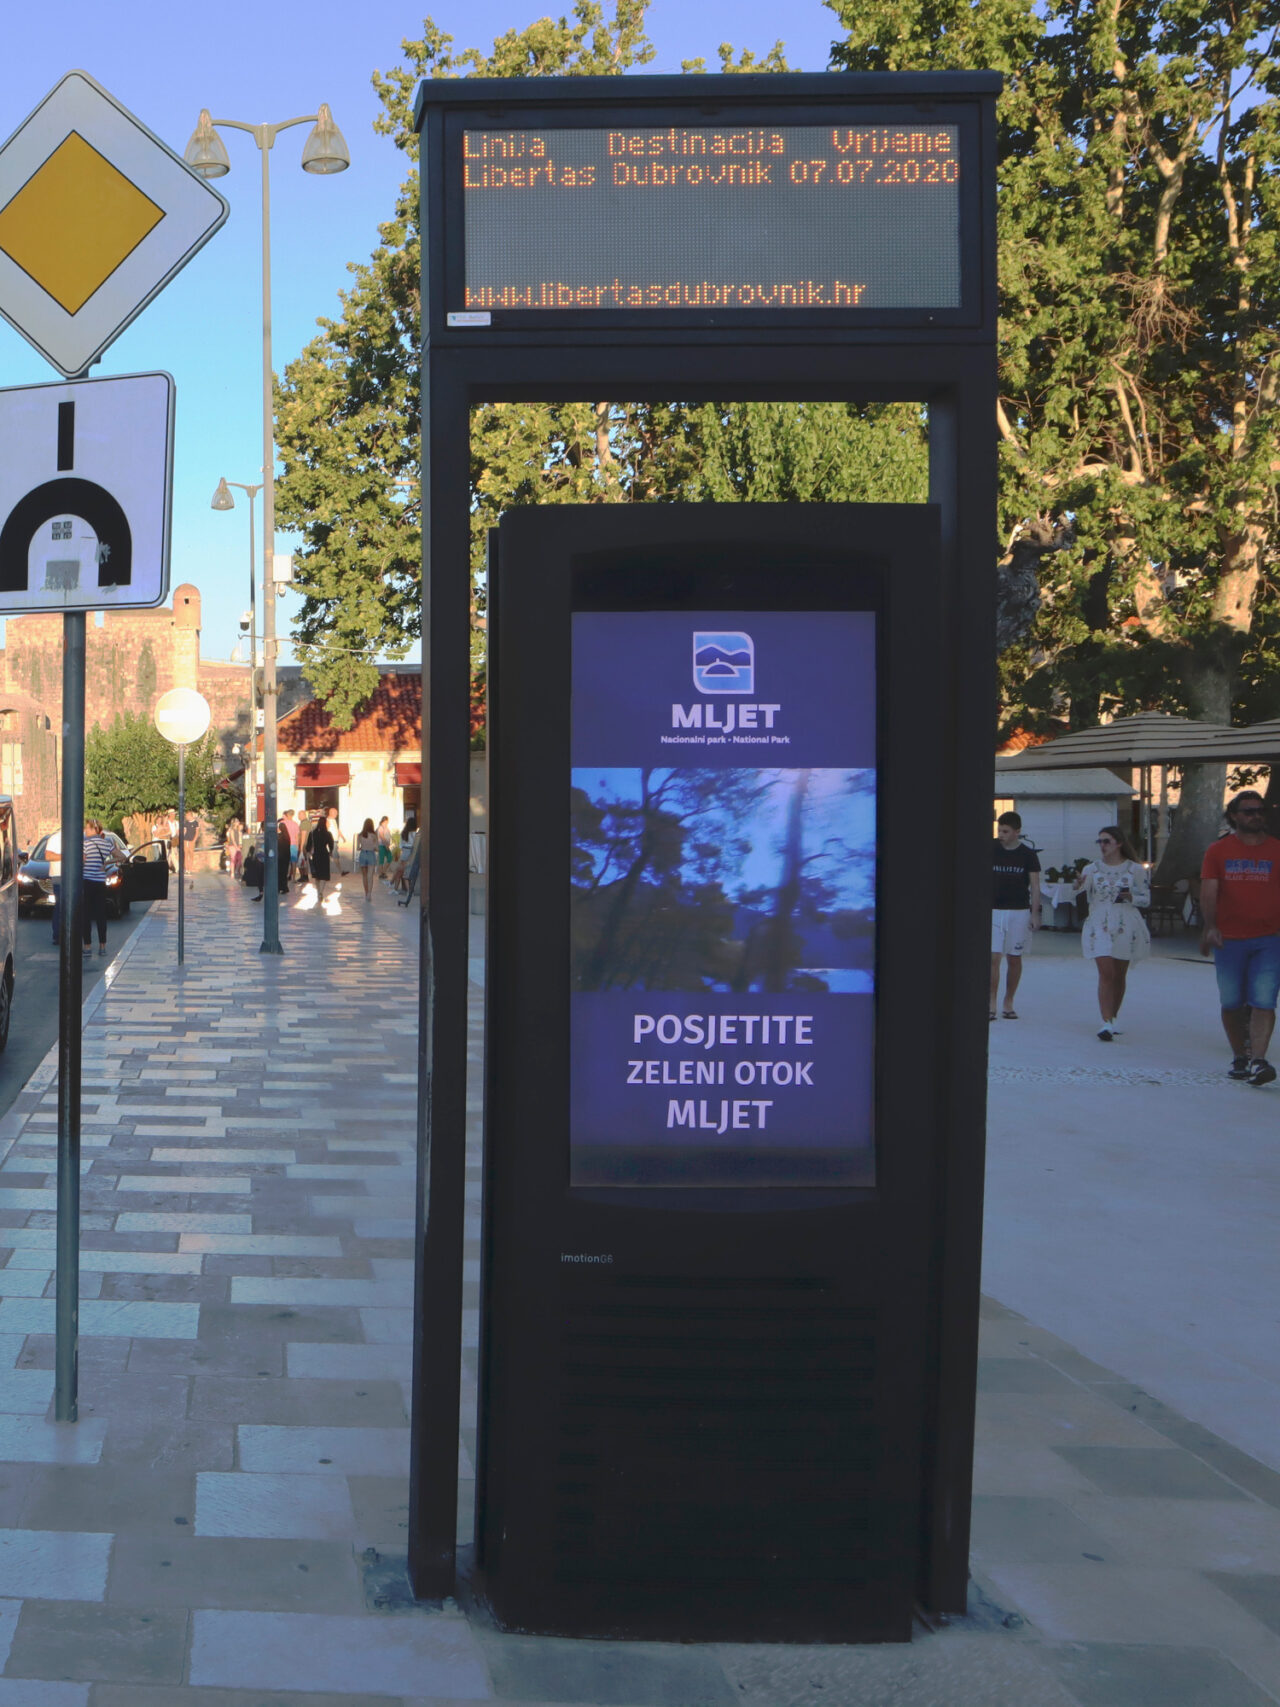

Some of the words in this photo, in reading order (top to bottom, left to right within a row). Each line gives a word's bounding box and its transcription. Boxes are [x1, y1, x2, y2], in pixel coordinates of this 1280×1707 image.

[463, 134, 545, 158] Linija
[608, 128, 784, 155] Destinacija
[832, 129, 951, 153] Vrijeme
[463, 160, 596, 187] Libertas
[613, 160, 772, 185] Dubrovnik
[789, 158, 959, 183] 07.07.2020
[464, 278, 867, 307] www.libertasdubrovnik.hr
[672, 703, 781, 734] MLJET
[660, 735, 706, 744] Nacionalni
[706, 735, 727, 746] park
[732, 735, 770, 744] National
[771, 735, 791, 744] Park
[632, 1013, 814, 1050] POSJETITE
[626, 1060, 725, 1085] ZELENI
[734, 1061, 815, 1086] OTOK
[666, 1099, 774, 1135] MLJET
